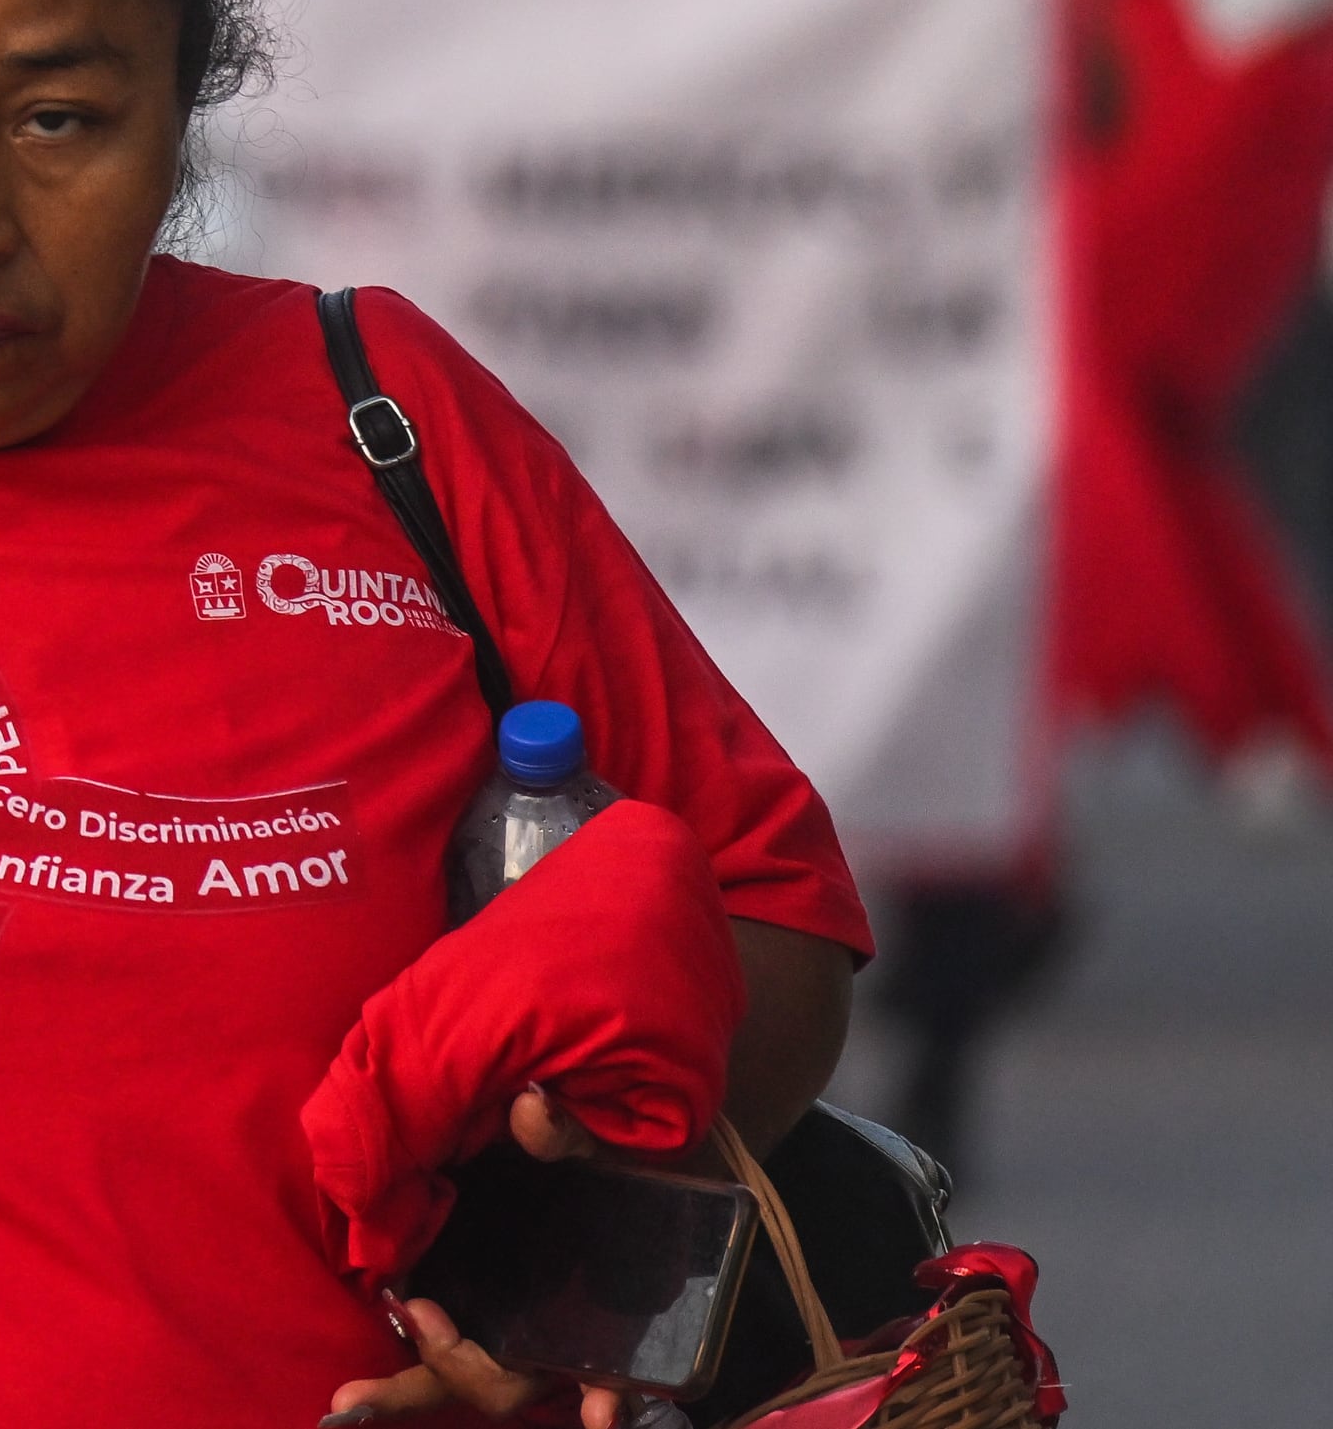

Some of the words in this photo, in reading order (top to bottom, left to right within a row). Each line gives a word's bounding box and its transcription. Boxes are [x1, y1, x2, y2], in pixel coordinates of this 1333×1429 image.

[257, 554, 446, 615] QUINTAN
[326, 602, 404, 625] ROO
[80, 808, 340, 843] Discriminación
[199, 850, 347, 896] Amor
